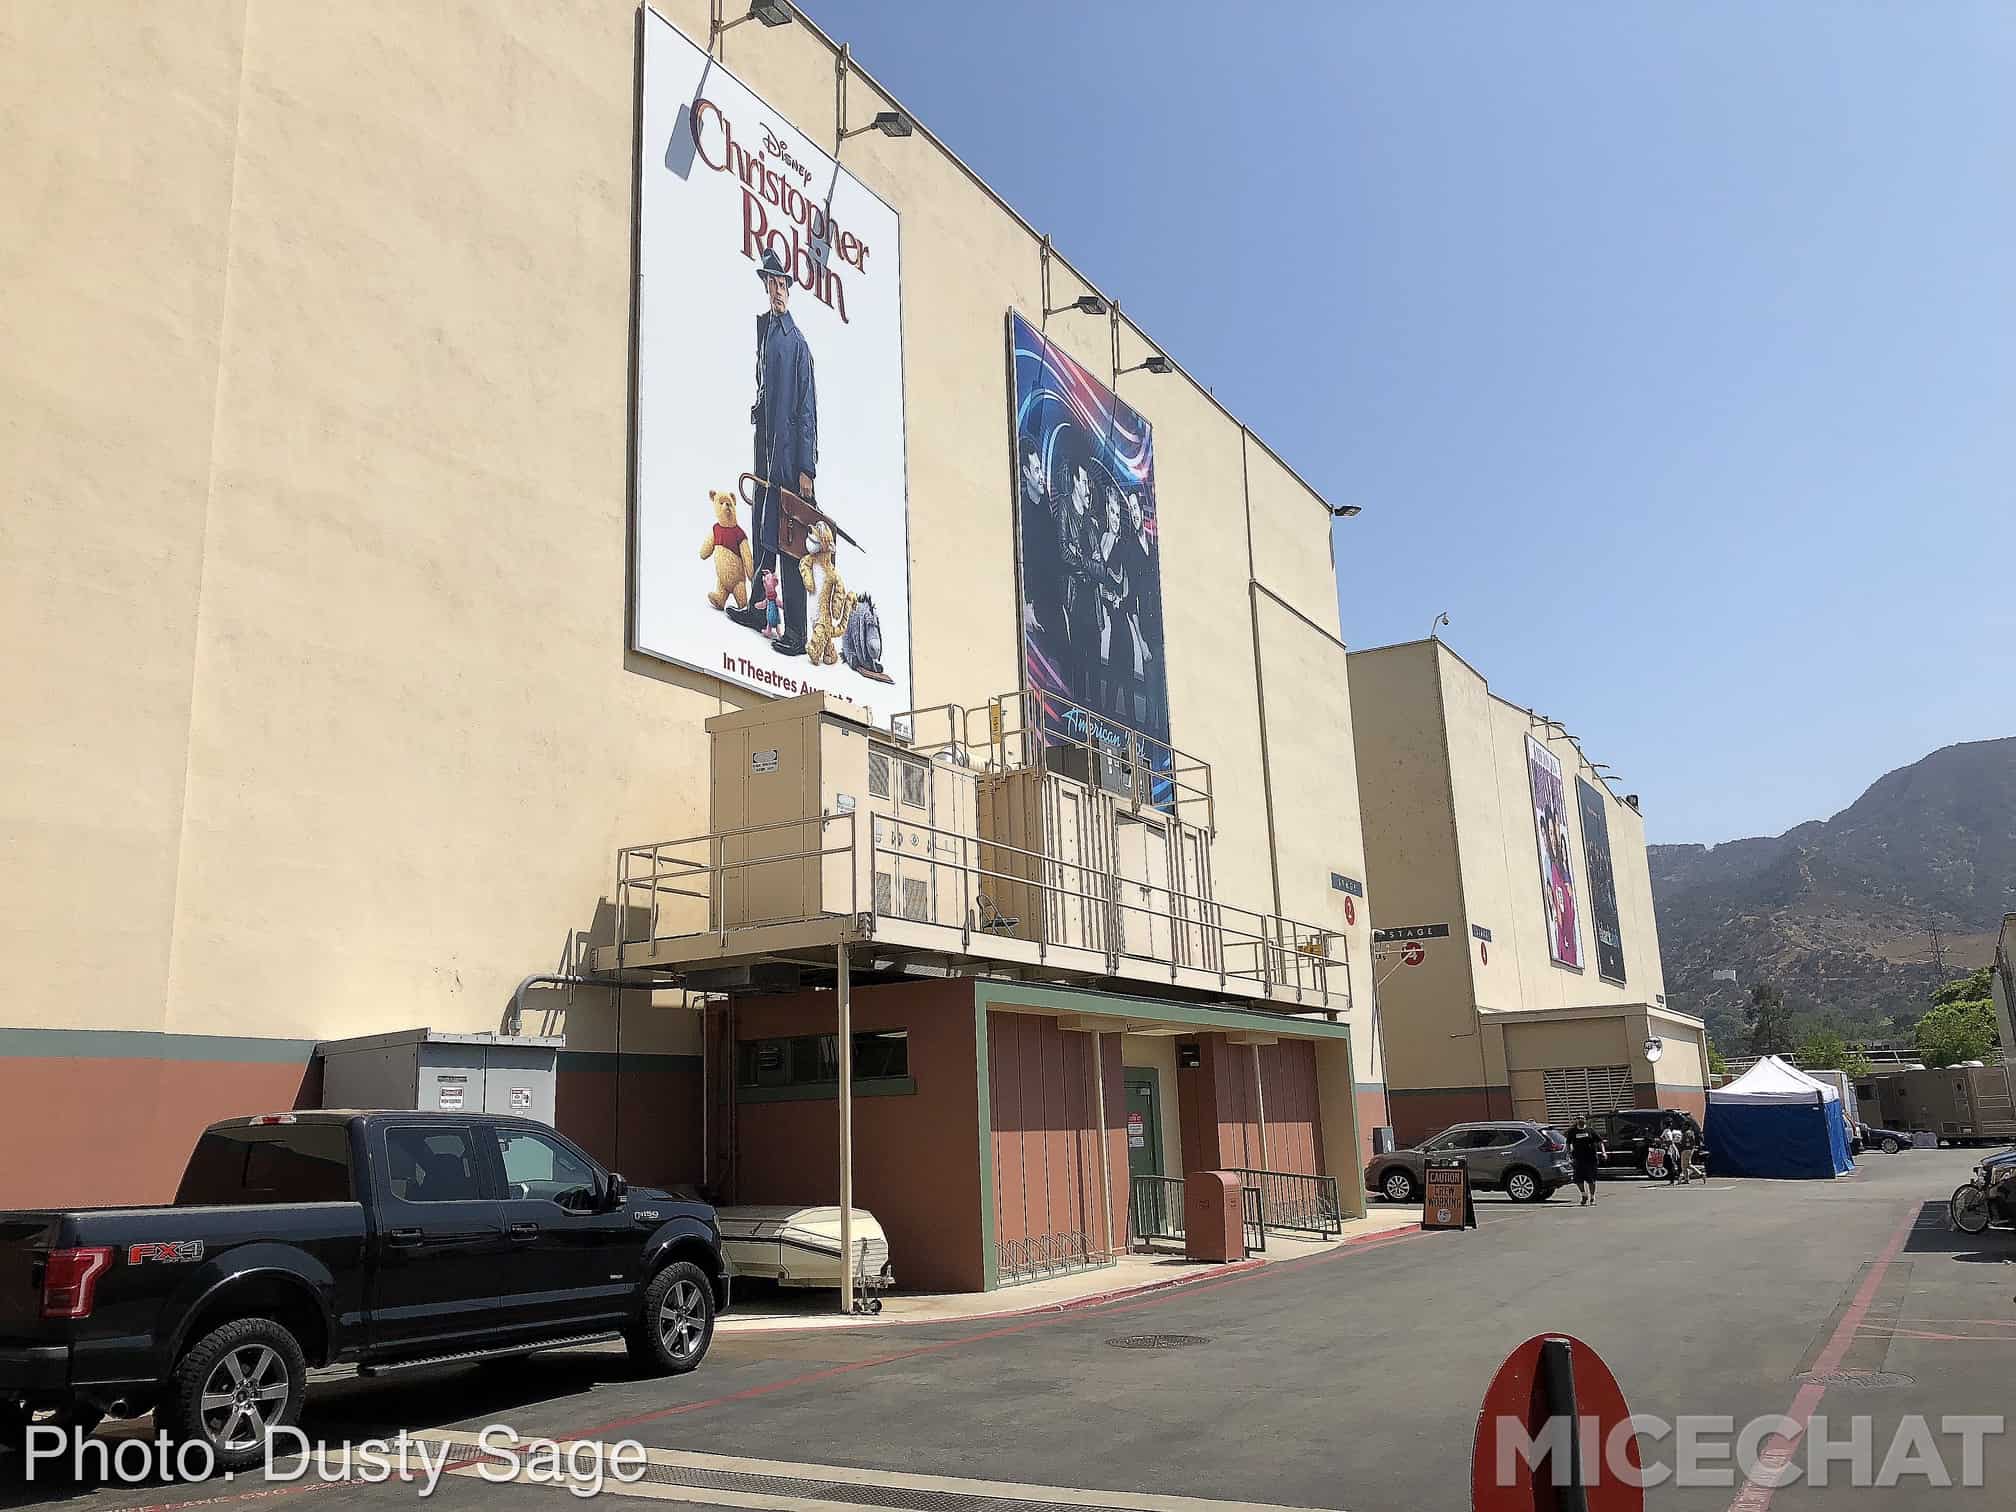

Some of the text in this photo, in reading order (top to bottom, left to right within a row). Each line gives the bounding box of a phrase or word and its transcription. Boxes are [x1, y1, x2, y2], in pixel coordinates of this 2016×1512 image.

[759, 121, 812, 187] Disney
[689, 98, 869, 275] Christopher
[740, 184, 849, 325] Robin
[722, 652, 735, 673] In
[737, 657, 797, 693] Theatres
[1061, 707, 1121, 747] American
[1389, 927, 1433, 938] STAGE
[1429, 1171, 1460, 1183] CAUTION
[1433, 1185, 1456, 1197] CREW
[1428, 1197, 1461, 1209] WORKING
[128, 1240, 204, 1265] FX4
